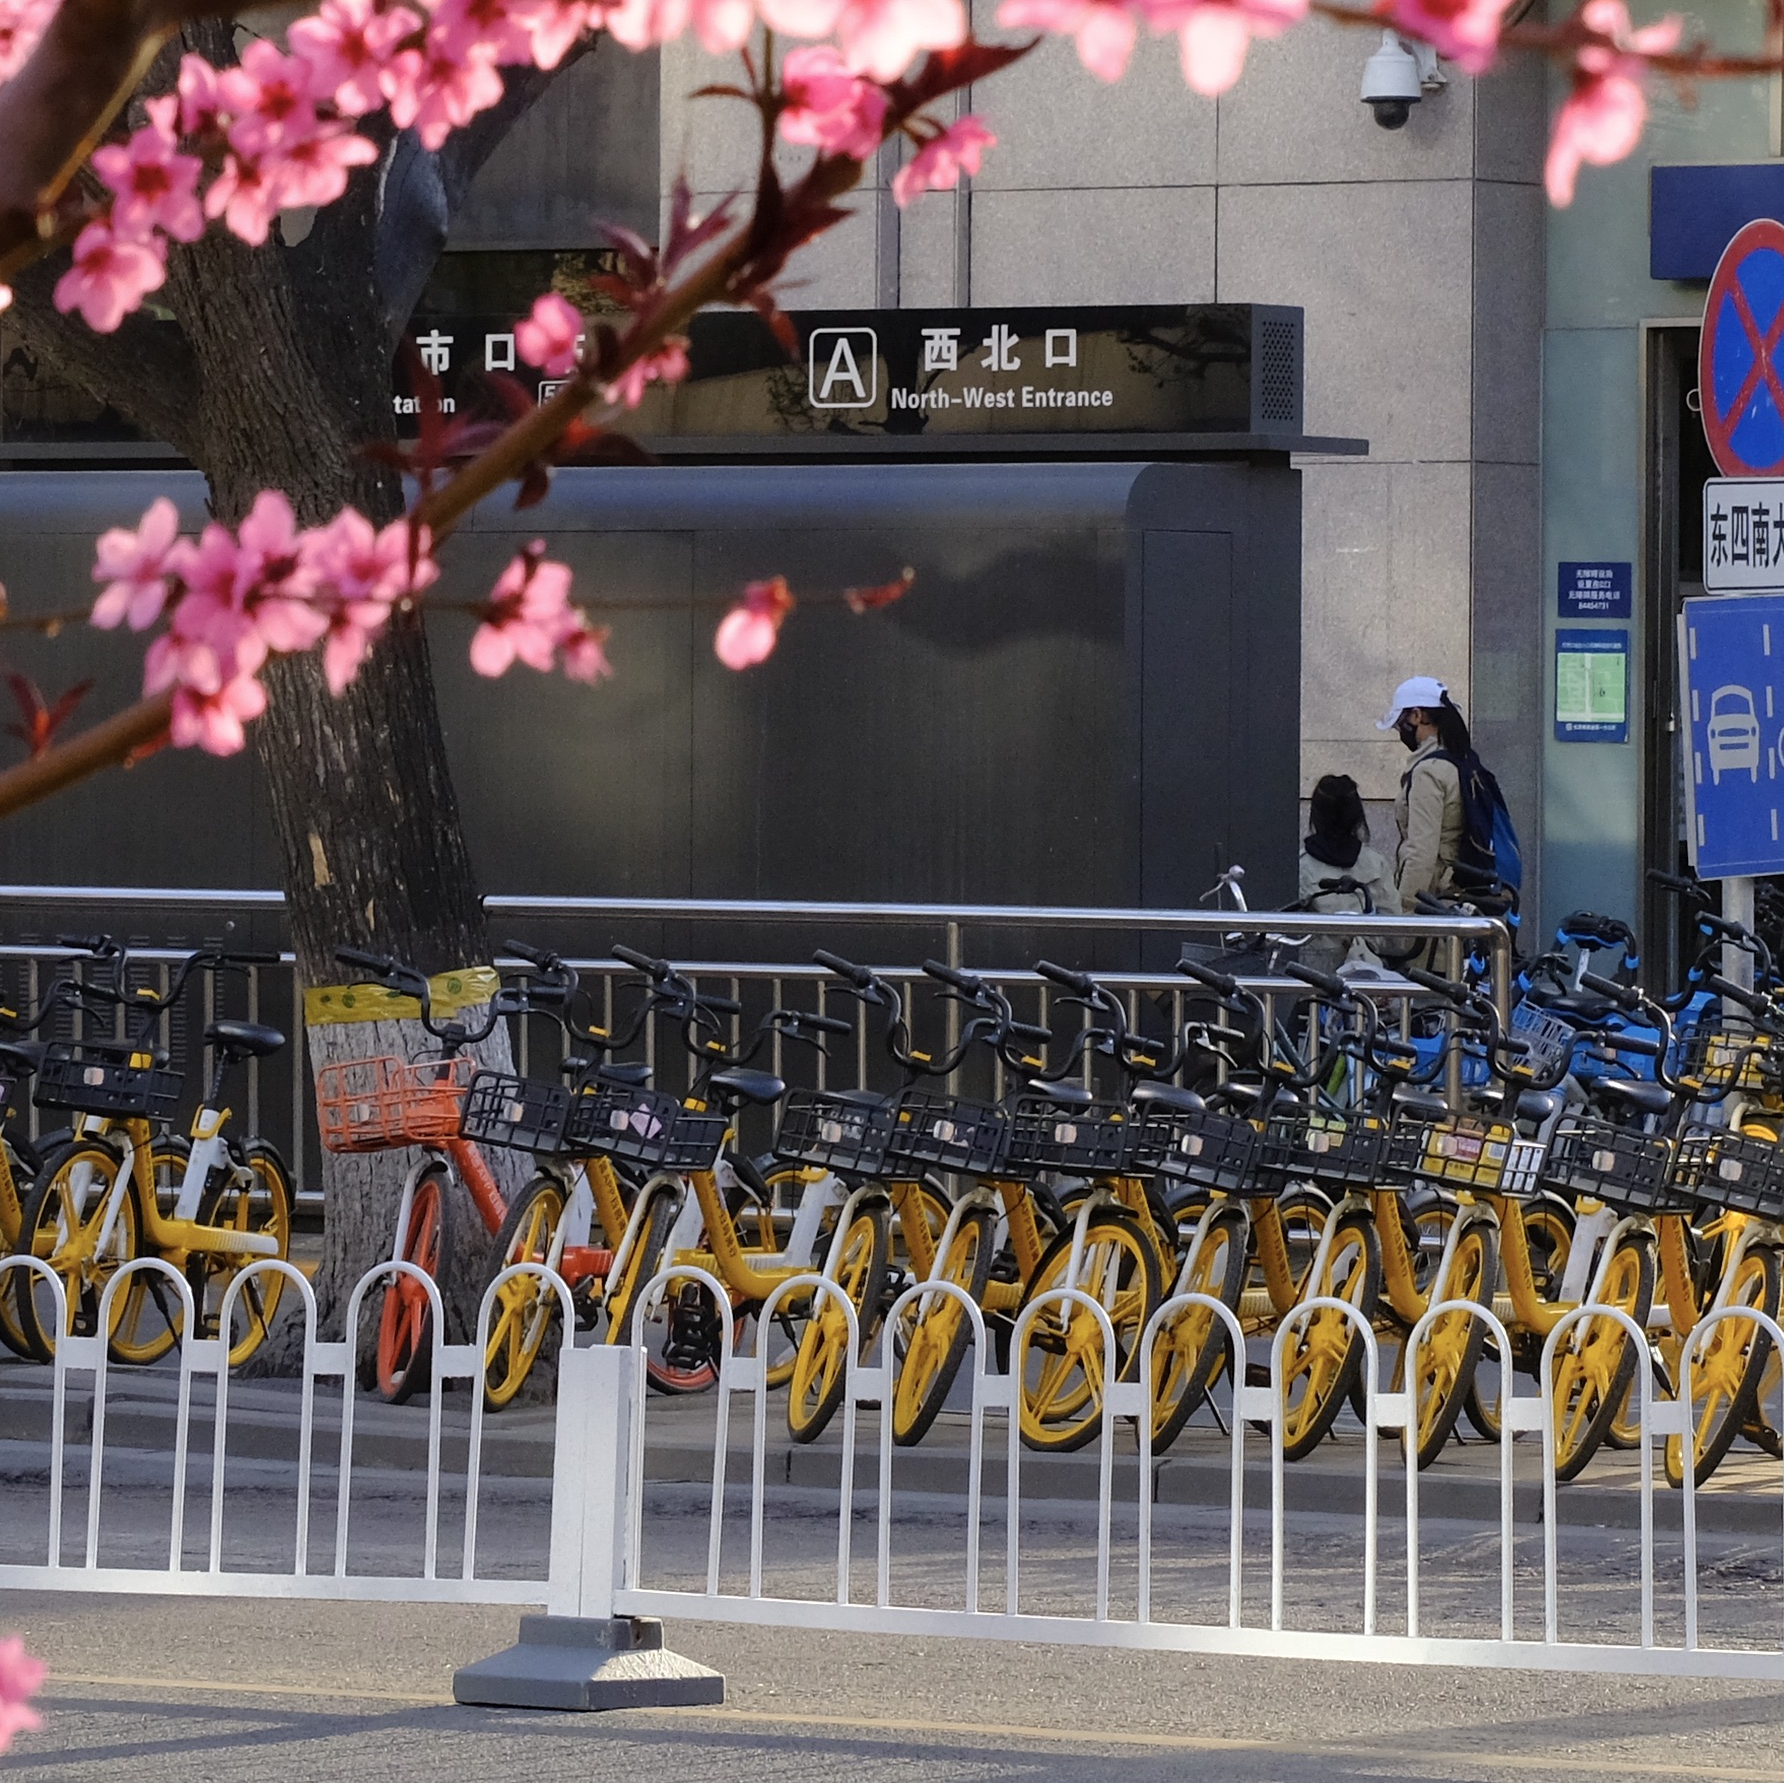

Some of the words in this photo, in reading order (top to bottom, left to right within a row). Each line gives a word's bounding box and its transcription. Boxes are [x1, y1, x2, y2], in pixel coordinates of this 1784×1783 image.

[818, 337, 867, 399] A
[921, 324, 1077, 372] 西北口
[1021, 386, 1114, 408] Entrance
